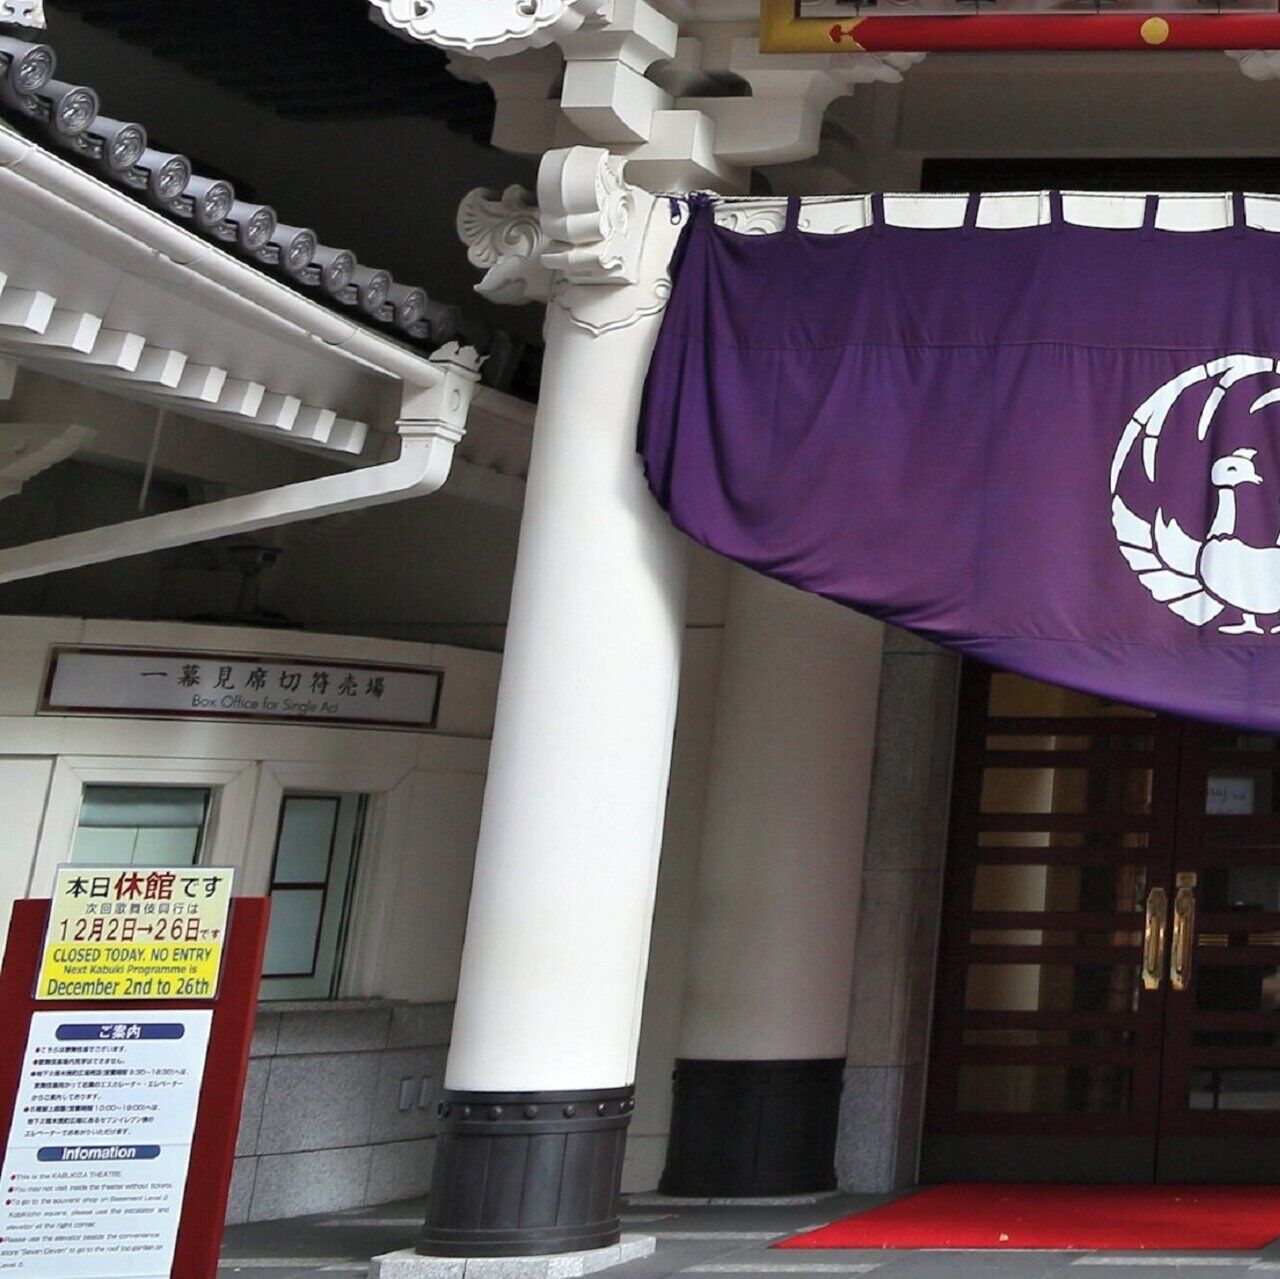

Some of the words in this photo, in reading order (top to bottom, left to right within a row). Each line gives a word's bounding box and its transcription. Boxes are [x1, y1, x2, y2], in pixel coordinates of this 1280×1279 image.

[139, 662, 386, 700] 一幕見席切符売場
[191, 694, 216, 708] Box
[220, 694, 259, 710] Office
[262, 696, 279, 710] for
[65, 871, 223, 901] 本日休館です
[85, 902, 199, 915] 次回歌舞伎興行は
[53, 948, 101, 963] CLOSED
[105, 948, 146, 962] TODAY.
[150, 948, 169, 961] NO
[172, 948, 213, 962] ENTRY
[63, 965, 87, 975] Next
[89, 965, 124, 974] Kabuki
[126, 965, 186, 976] Programme
[189, 964, 197, 974] is
[46, 978, 120, 996] December
[124, 978, 153, 995] 2nd
[156, 978, 171, 995] to
[176, 978, 210, 995] 26th
[99, 1024, 142, 1040] ご案内
[62, 1146, 136, 1160] Infomation
